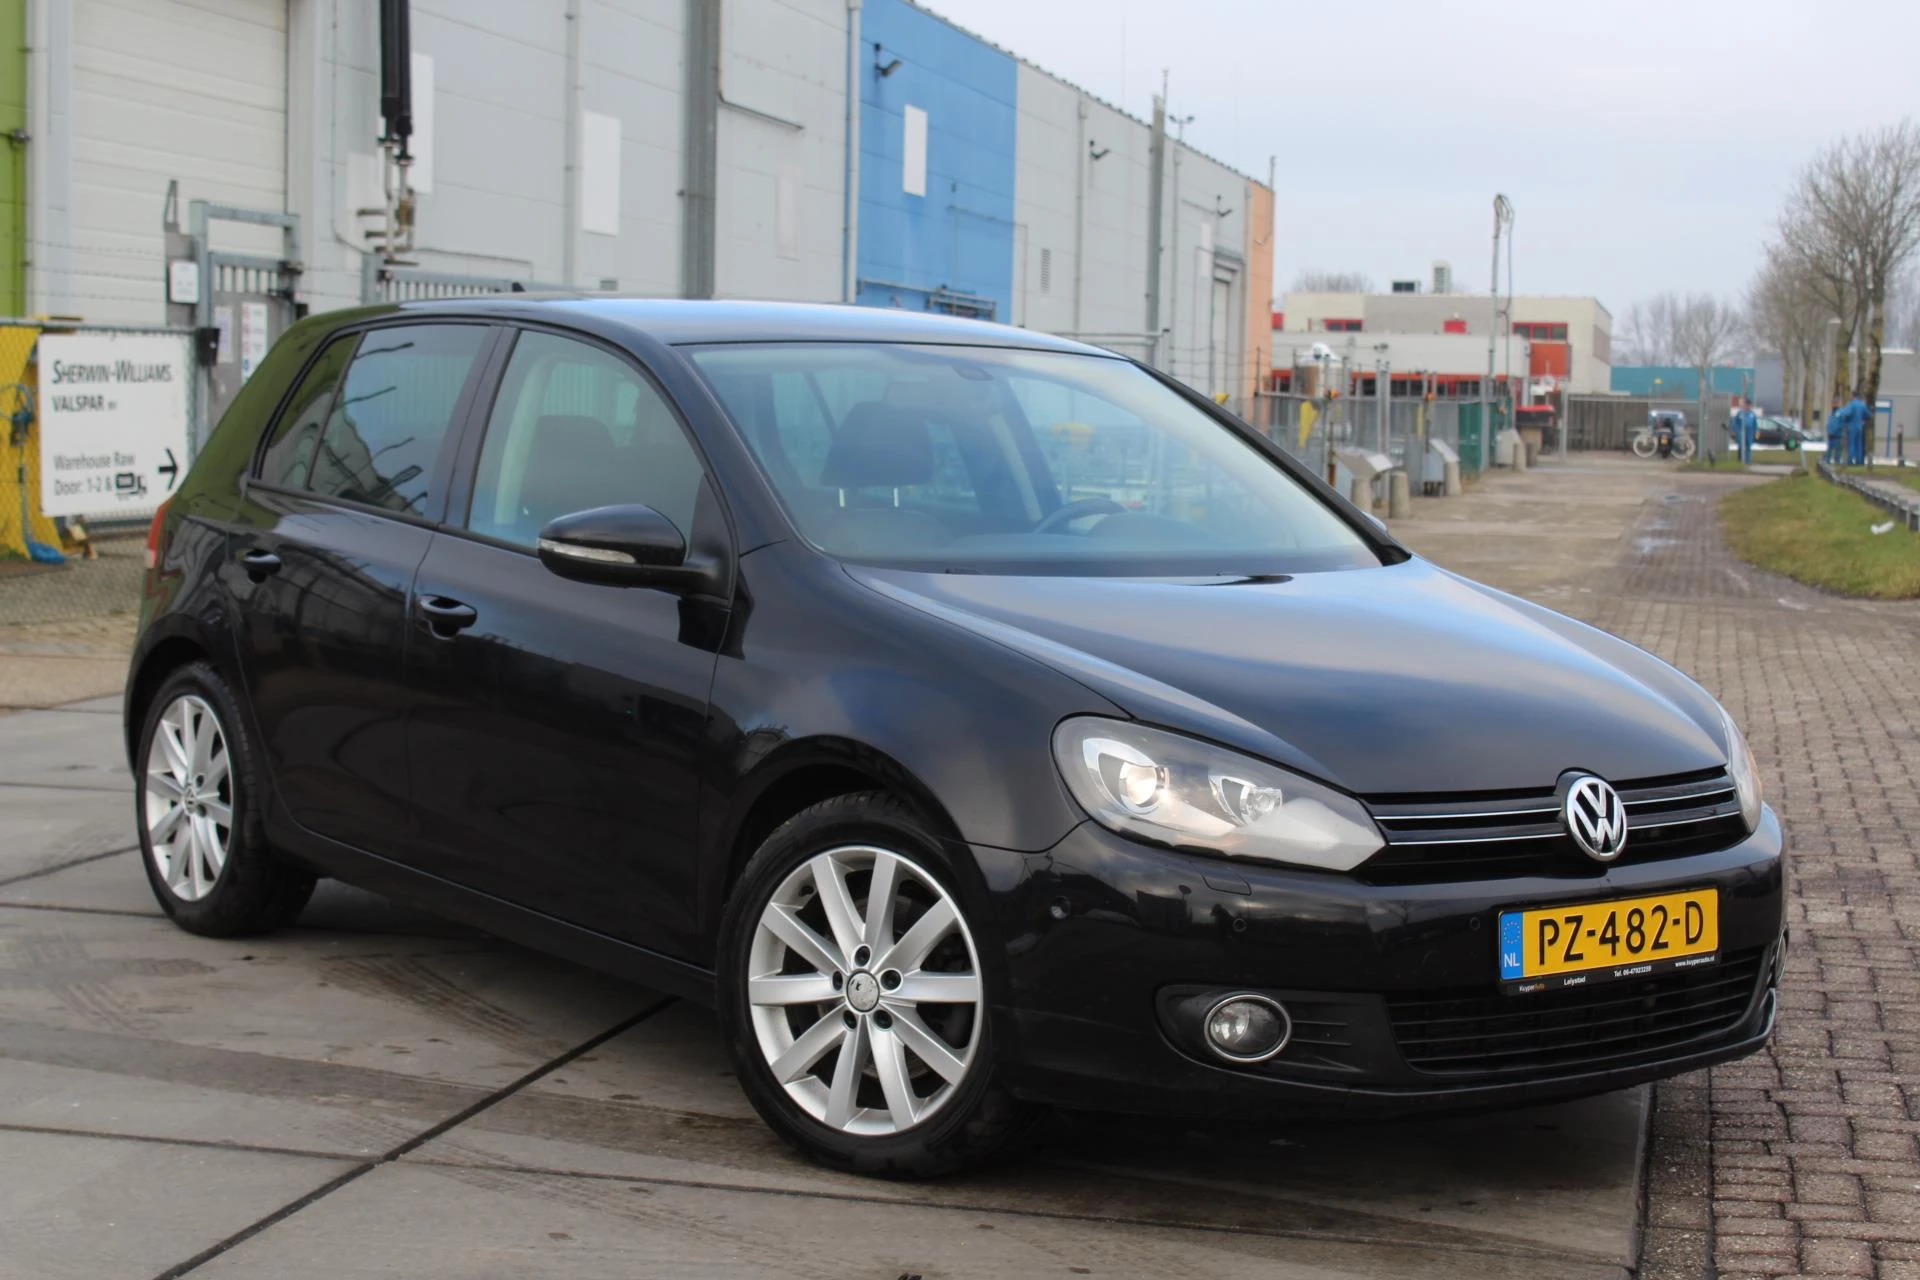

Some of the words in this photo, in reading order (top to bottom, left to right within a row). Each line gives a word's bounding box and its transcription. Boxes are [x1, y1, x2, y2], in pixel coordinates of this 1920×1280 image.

[53, 395, 103, 411] VALSPAR
[54, 453, 110, 470] Warehouse
[114, 451, 134, 464] Raw
[1538, 900, 1704, 966] PZ-482-D
[1503, 952, 1520, 968] NL
[1563, 976, 1586, 986] Lelystad
